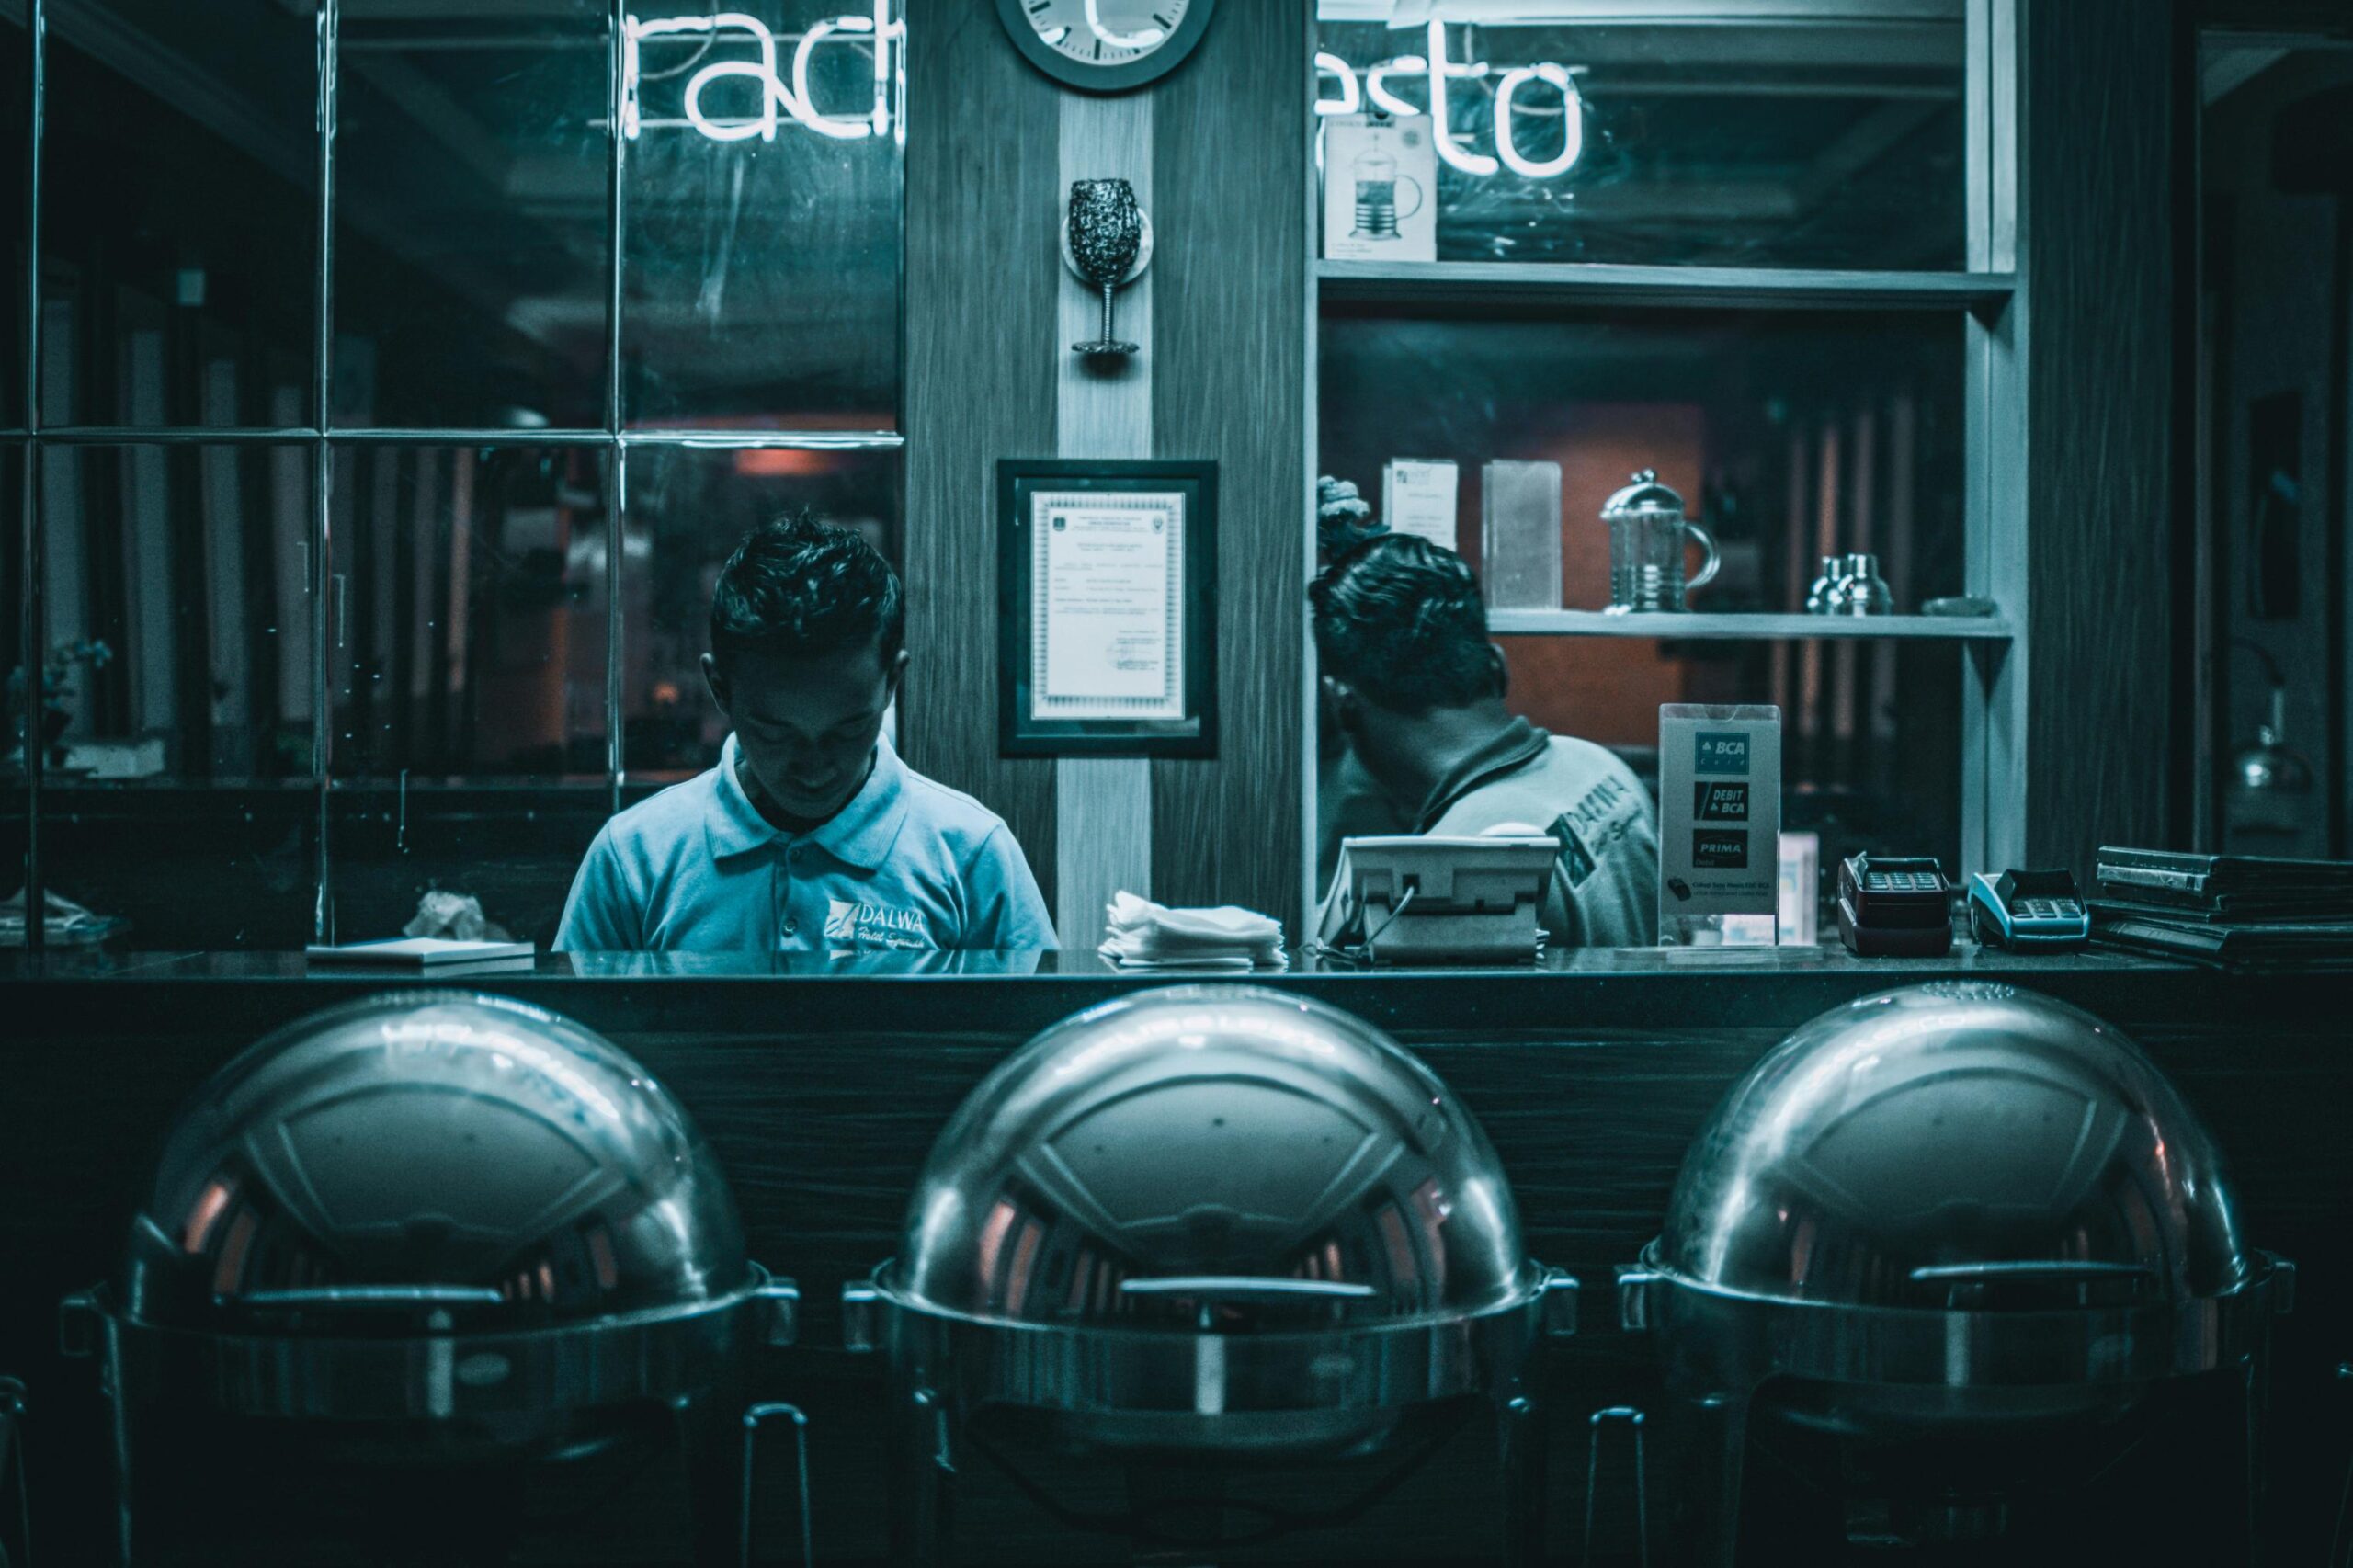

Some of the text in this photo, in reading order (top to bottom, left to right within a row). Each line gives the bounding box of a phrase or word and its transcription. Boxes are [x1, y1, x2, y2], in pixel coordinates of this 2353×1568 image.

[1715, 741, 1745, 755] BCA
[1712, 789, 1744, 801] DEBIT
[1721, 802, 1745, 814] BCA
[1699, 843, 1742, 853] PRIMA
[859, 903, 925, 933] DALWA
